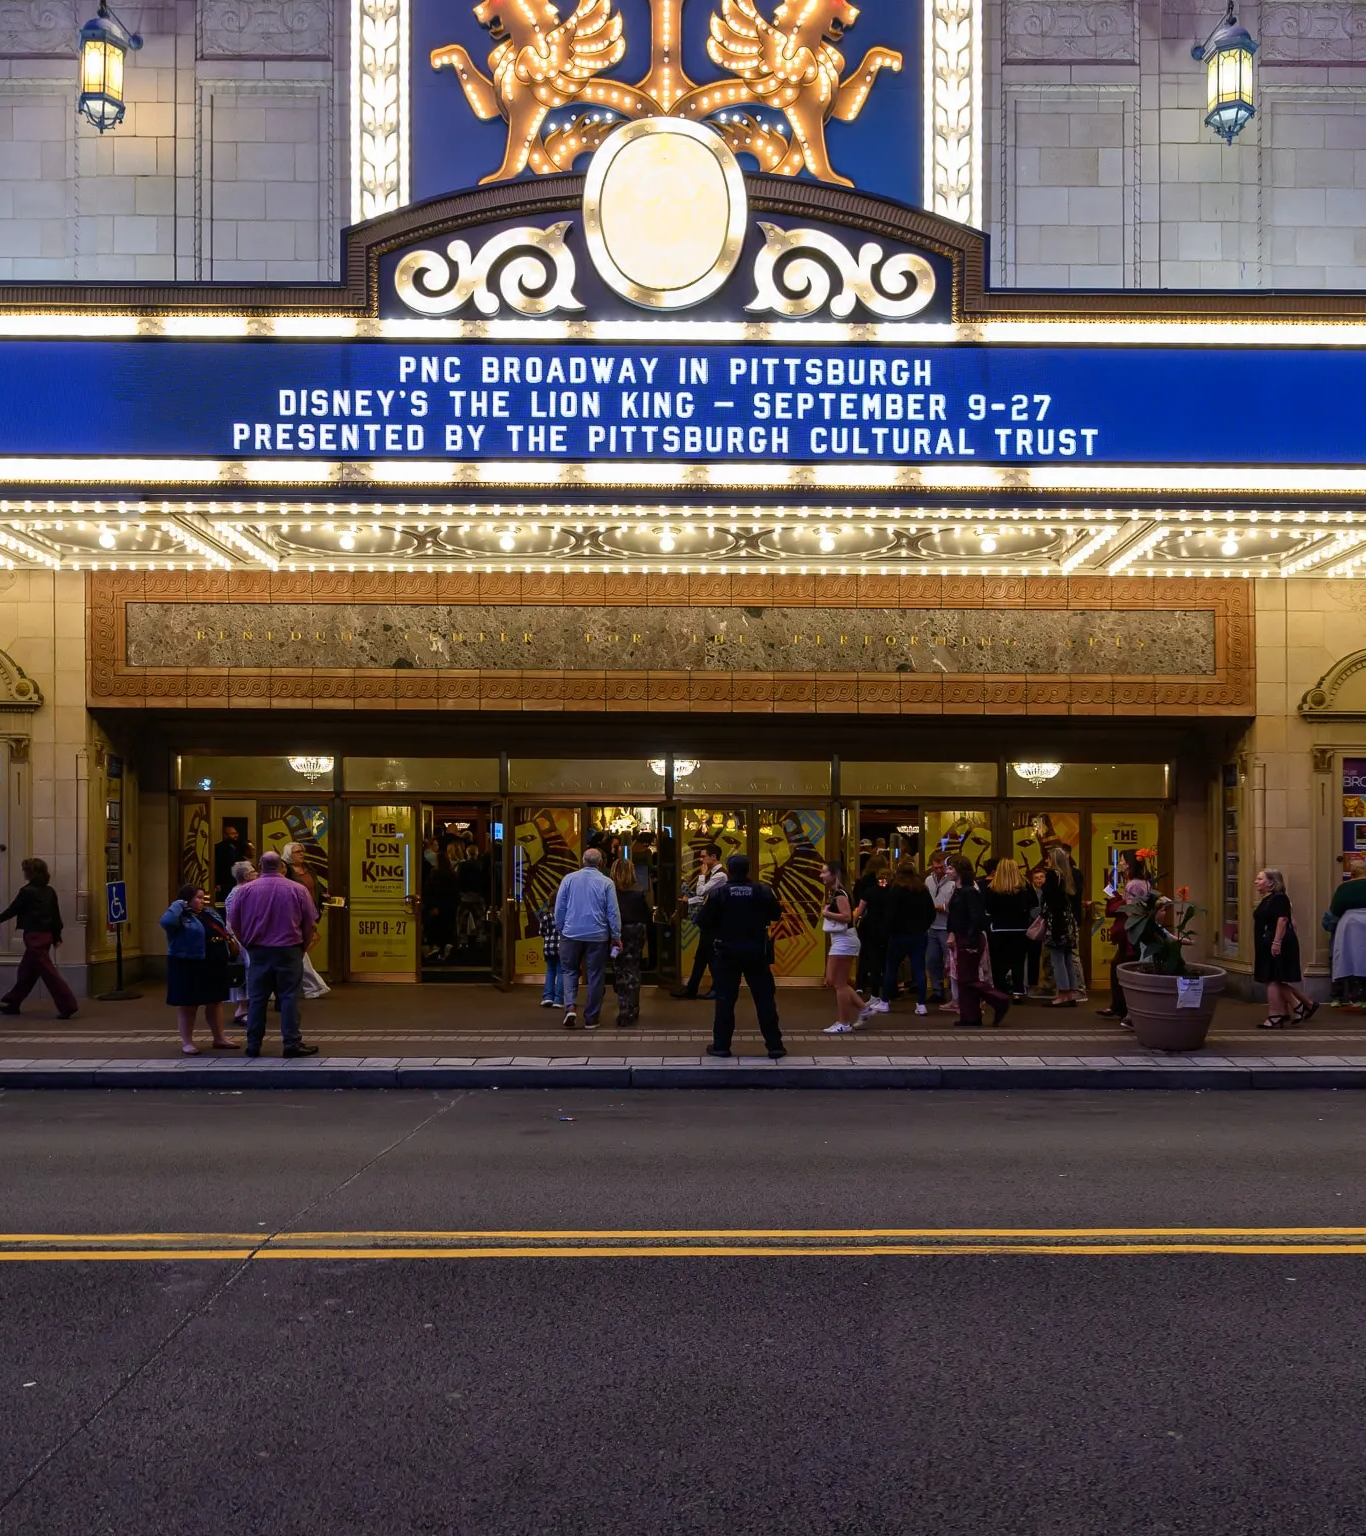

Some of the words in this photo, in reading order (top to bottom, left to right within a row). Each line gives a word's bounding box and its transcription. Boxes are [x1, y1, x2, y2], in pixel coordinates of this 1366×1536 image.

[399, 356, 461, 383] PNC
[481, 357, 659, 384] BROADWAY
[679, 357, 709, 385] IN
[729, 357, 932, 386] PITTSBURGH
[279, 389, 428, 417] DISNEY'S
[449, 390, 510, 418] THE
[530, 390, 601, 418] LION
[621, 391, 695, 419] KING
[753, 392, 947, 421] SEPTEMBER
[968, 393, 1052, 421] 9-27
[233, 422, 425, 451] PRESENTED
[445, 424, 486, 452] BY
[506, 424, 568, 452] THE
[588, 425, 789, 454] PITTSBURGH
[810, 426, 975, 455] CULTURAL
[994, 428, 1099, 456] TRUST
[195, 630, 354, 642] BENEDUM
[403, 631, 533, 643] CENTER
[584, 632, 643, 644] FOR
[690, 633, 748, 645] THE
[792, 633, 1018, 647] PERFORMING
[1063, 635, 1147, 648] ARTS
[370, 823, 396, 834] THE
[1112, 830, 1138, 841] THE
[366, 839, 400, 859] LION
[361, 860, 404, 883] KING
[358, 921, 381, 936] SEPT
[383, 921, 389, 936] 9
[396, 921, 408, 936] 27
